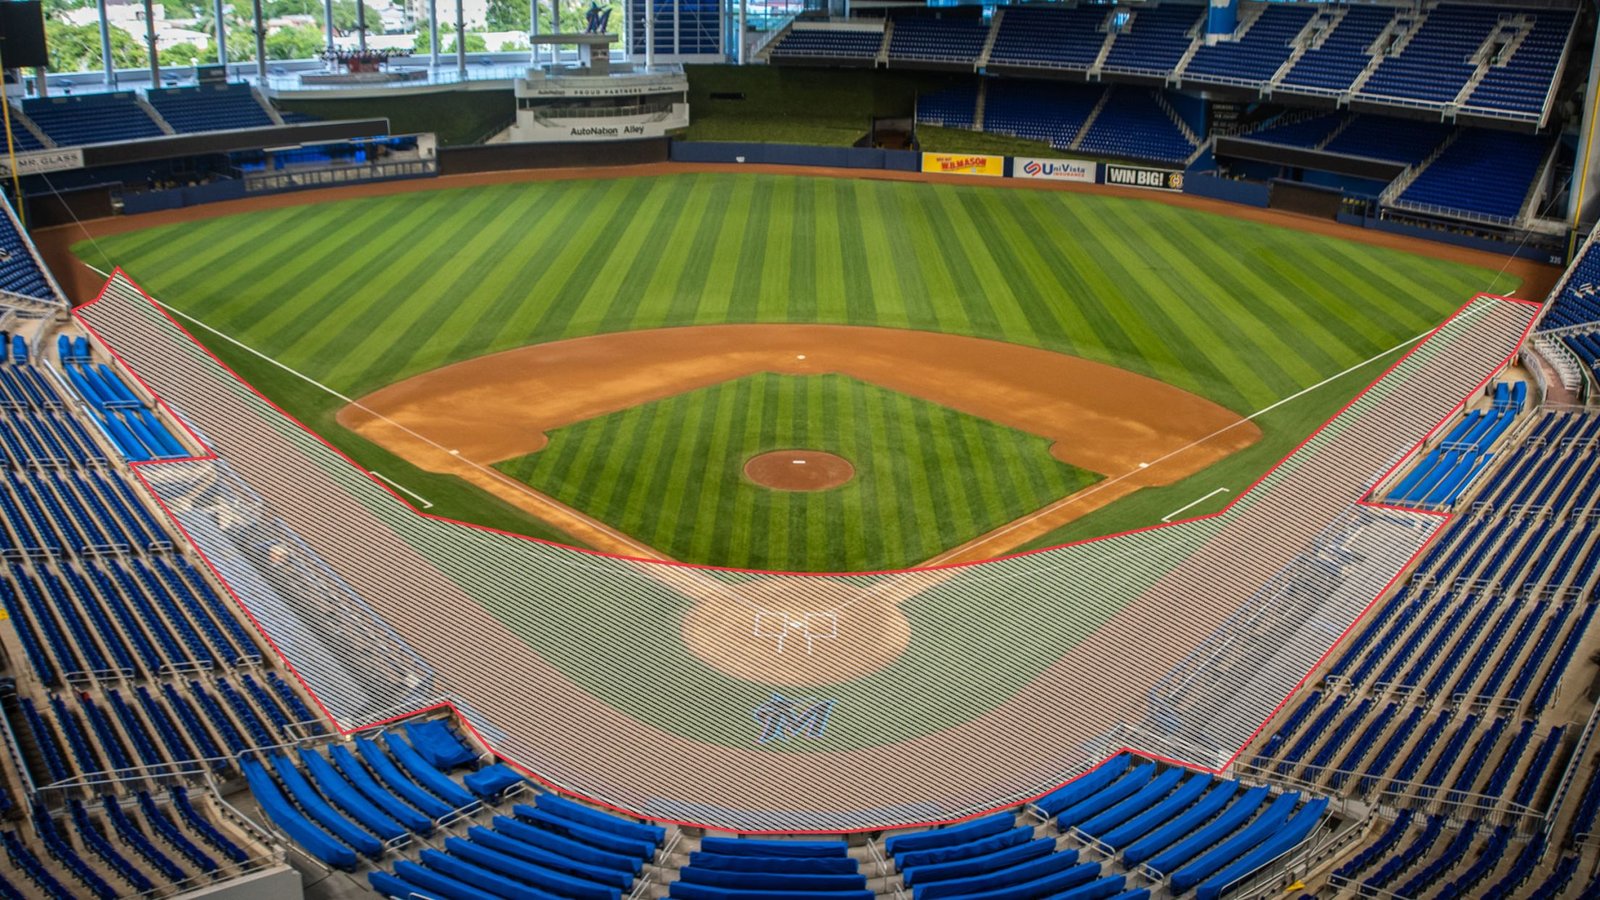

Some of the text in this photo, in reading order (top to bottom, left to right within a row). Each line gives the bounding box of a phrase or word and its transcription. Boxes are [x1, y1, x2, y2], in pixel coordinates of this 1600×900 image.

[570, 125, 645, 136] AutoNation Alley
[41, 154, 78, 165] GLASS
[1042, 163, 1086, 176] UniVista
[1110, 168, 1164, 187] WIN BIG!
